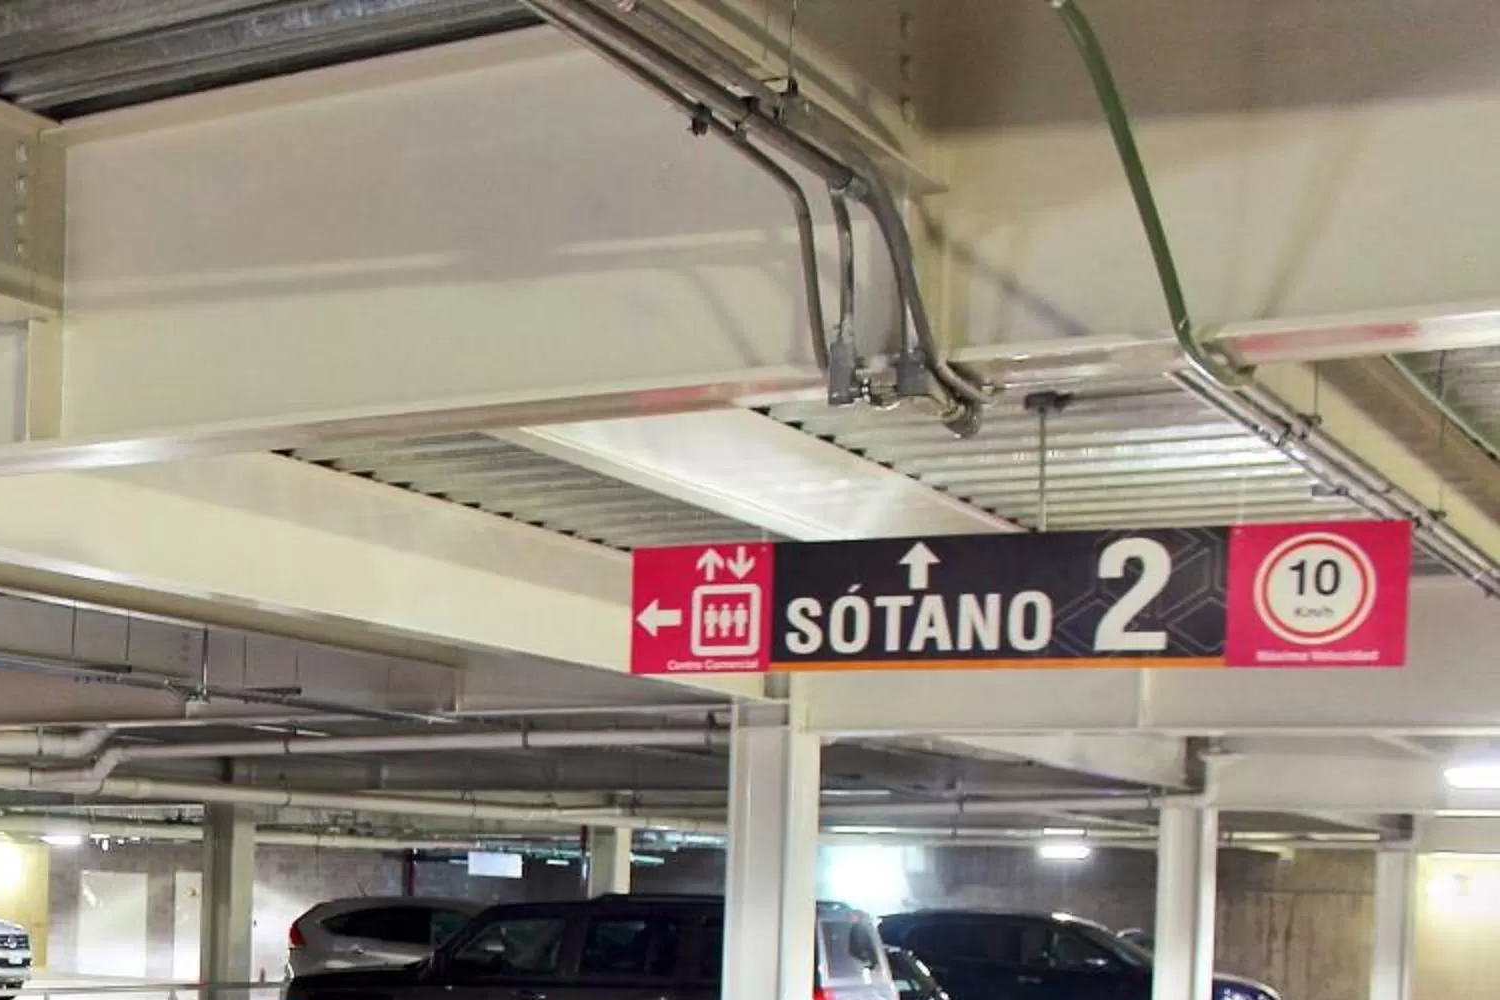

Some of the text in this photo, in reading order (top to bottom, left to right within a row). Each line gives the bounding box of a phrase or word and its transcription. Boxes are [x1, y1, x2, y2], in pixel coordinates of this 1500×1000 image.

[784, 537, 1173, 655] SÓTANO 2
[1288, 558, 1341, 597] 10
